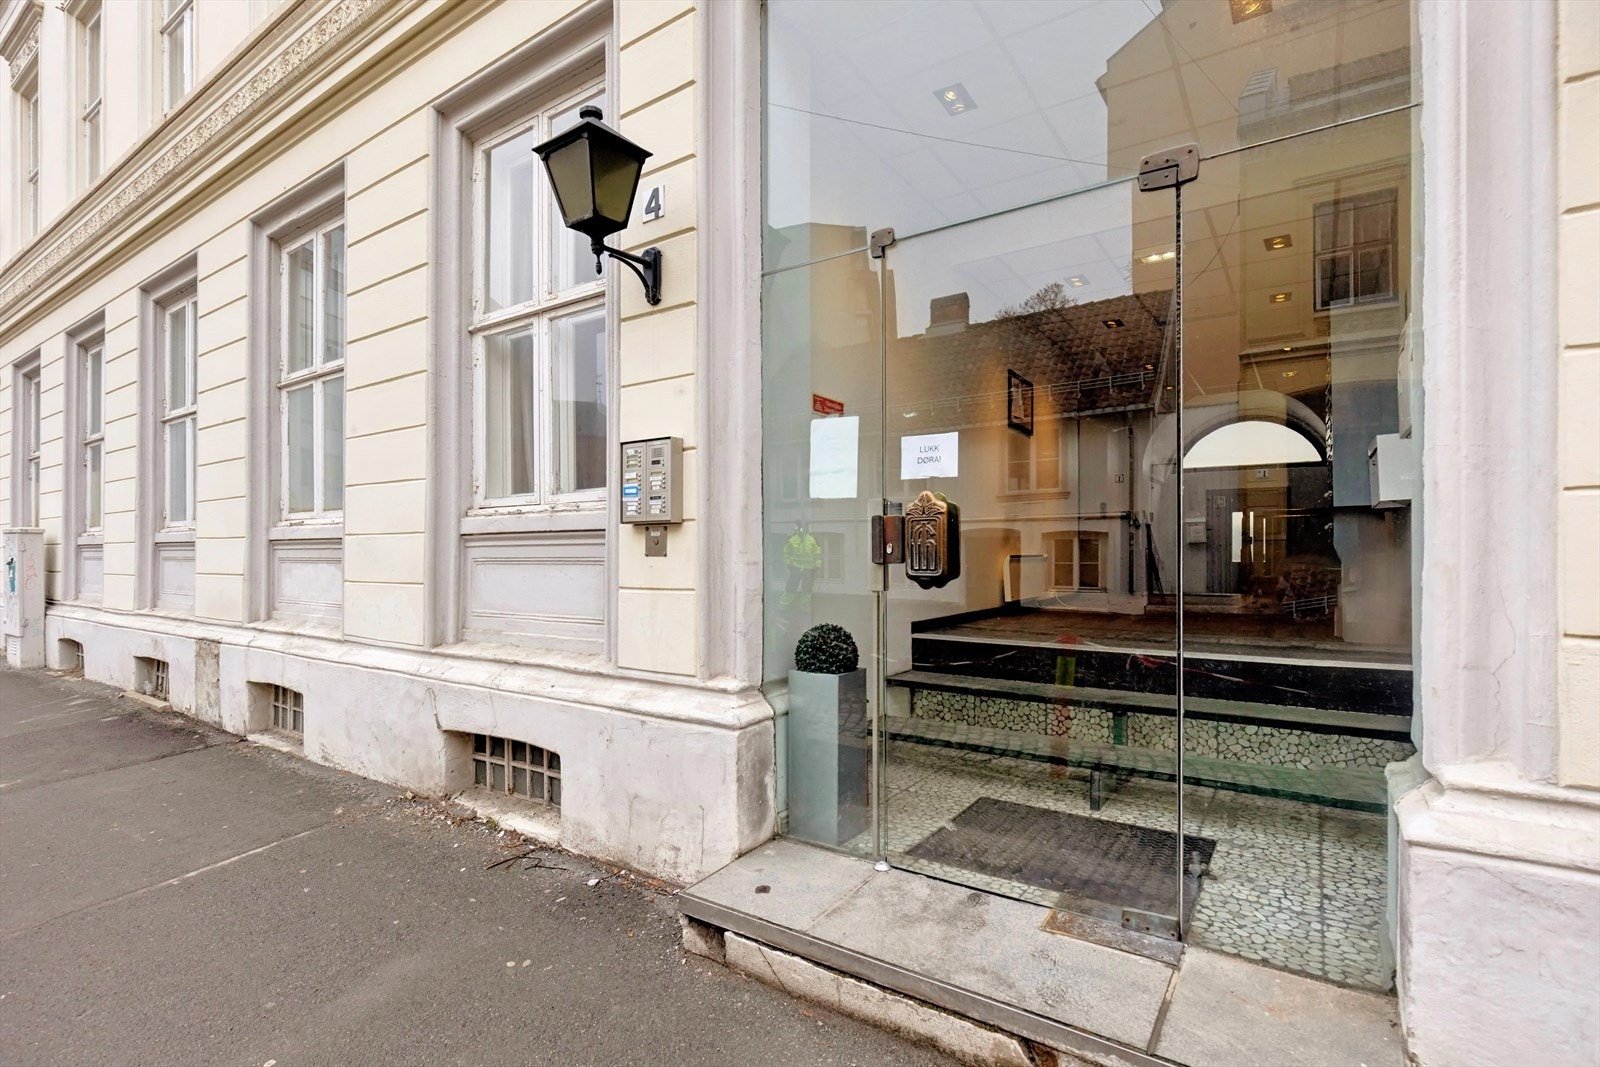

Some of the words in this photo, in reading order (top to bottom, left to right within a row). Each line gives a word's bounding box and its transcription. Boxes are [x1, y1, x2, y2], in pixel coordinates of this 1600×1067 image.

[645, 187, 661, 219] 4
[919, 445, 939, 453] LUKK
[917, 456, 941, 464] DØRA!
